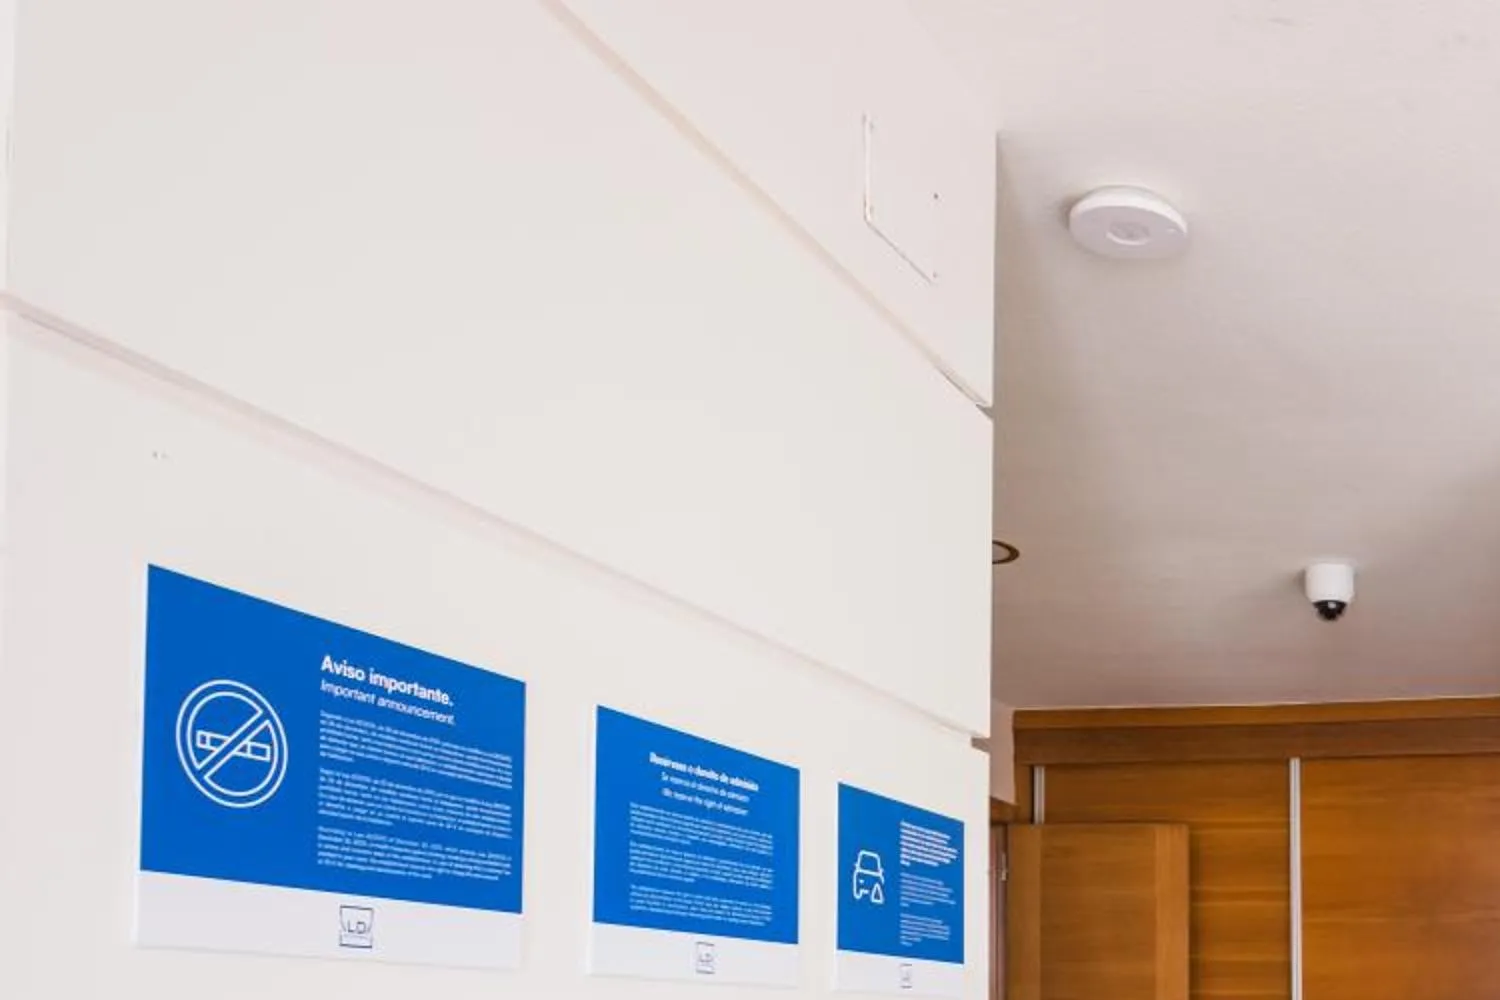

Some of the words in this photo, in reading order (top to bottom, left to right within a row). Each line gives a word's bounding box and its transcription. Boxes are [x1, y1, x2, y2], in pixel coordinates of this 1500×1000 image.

[320, 654, 365, 682] Aviso
[368, 667, 454, 707] importante.
[320, 679, 375, 706] Important
